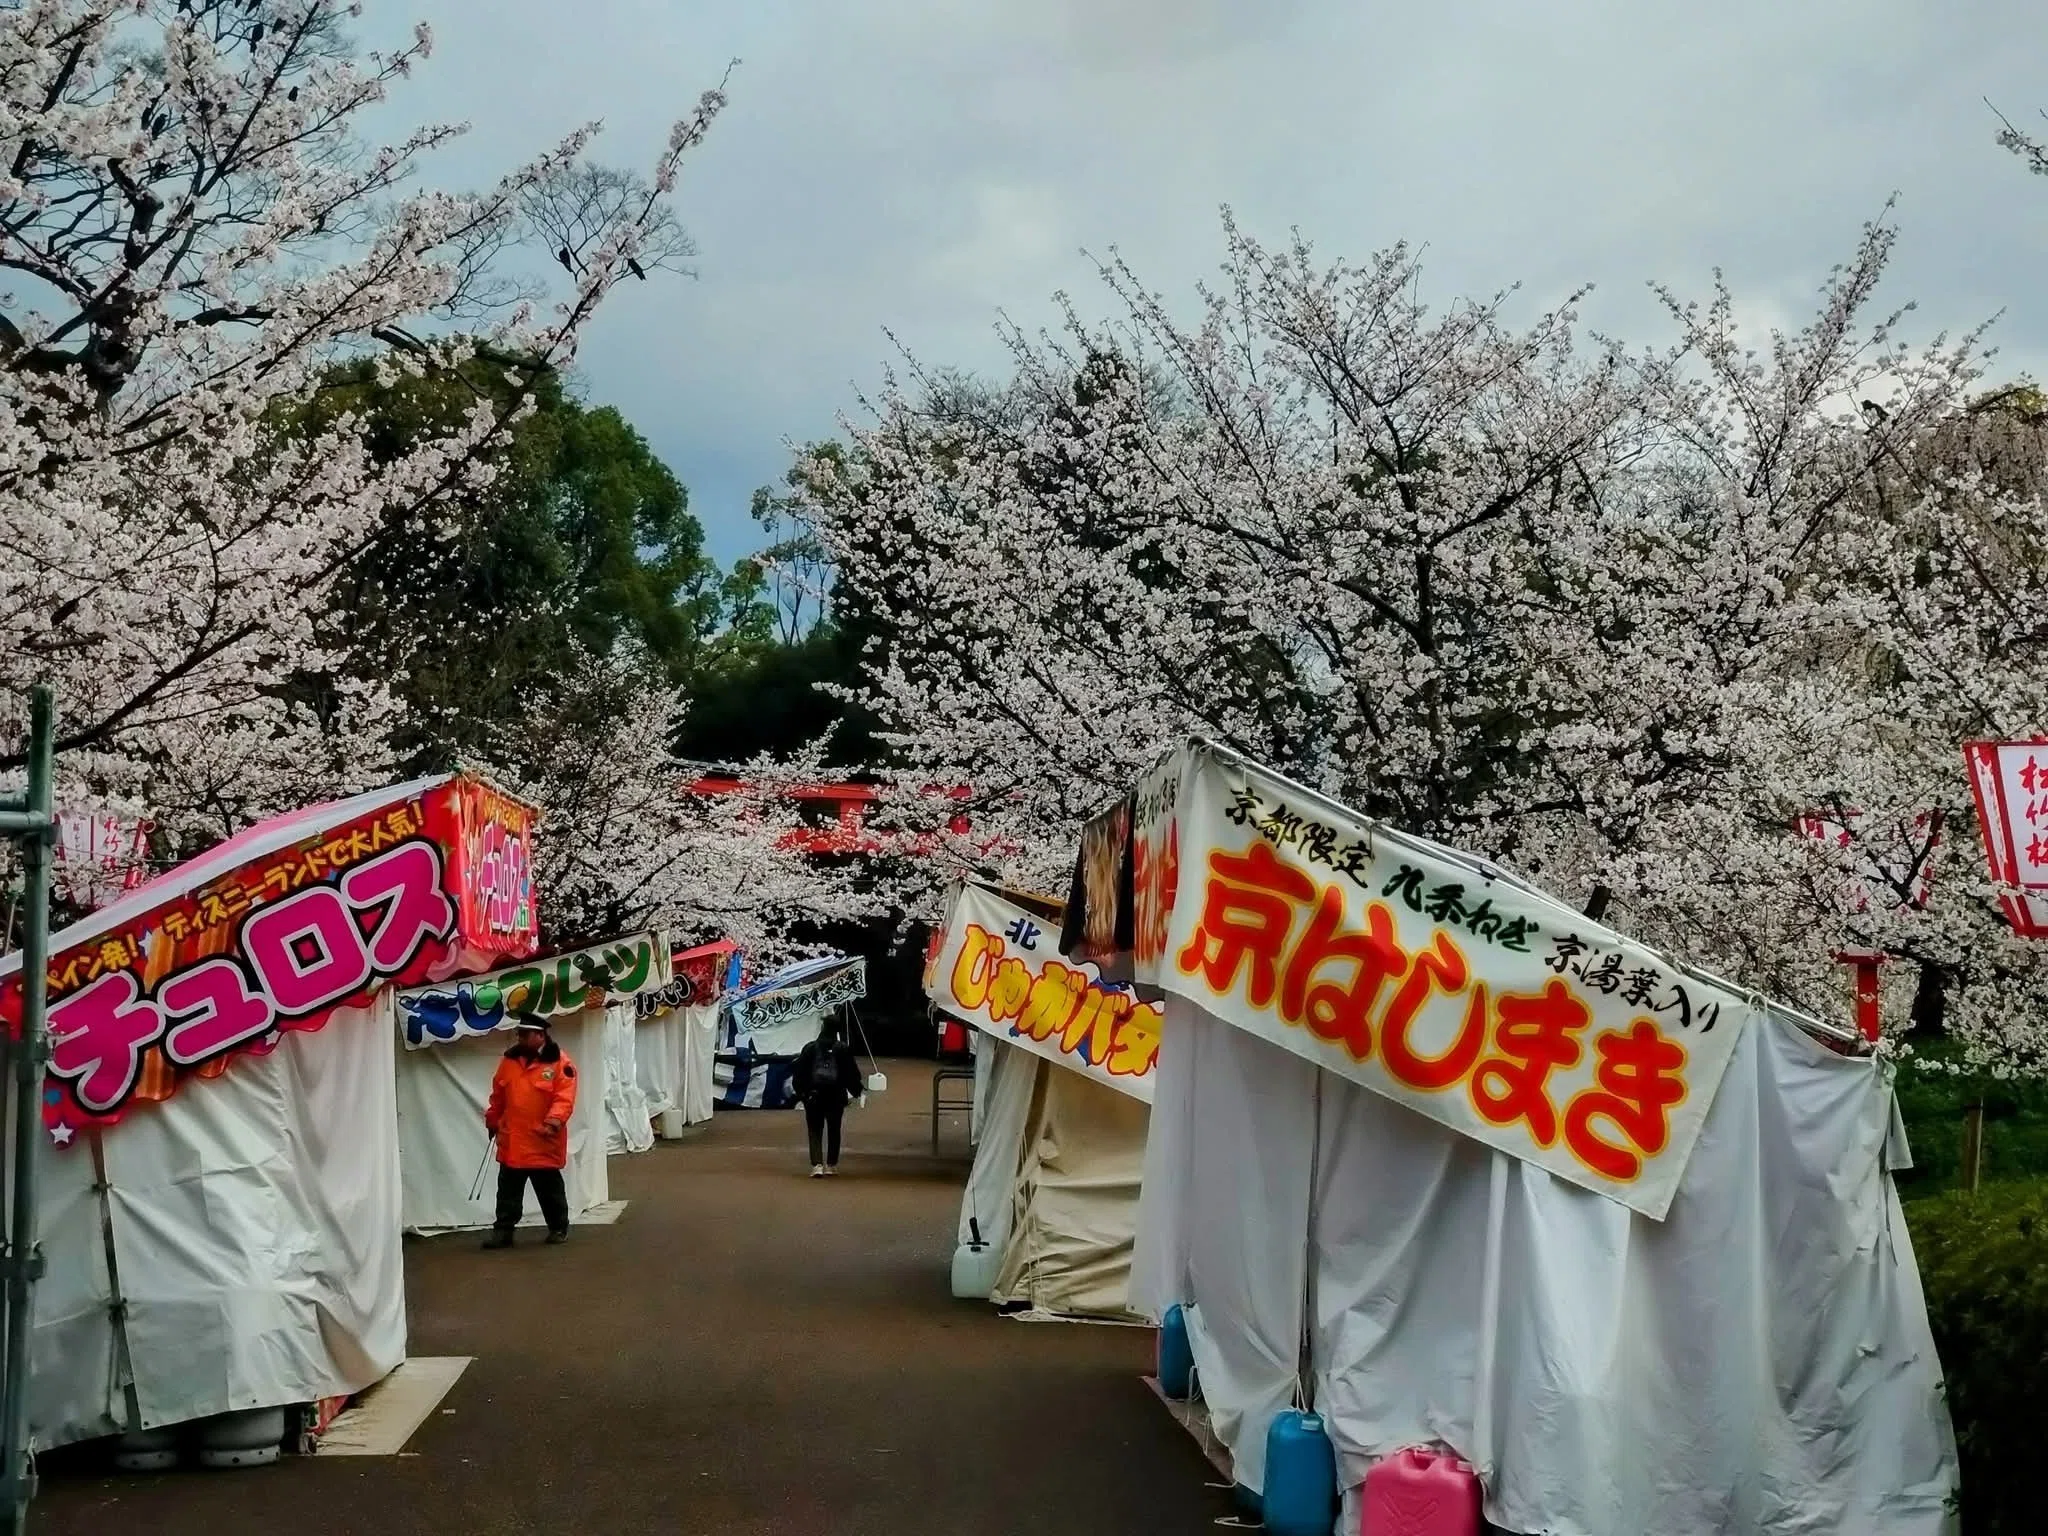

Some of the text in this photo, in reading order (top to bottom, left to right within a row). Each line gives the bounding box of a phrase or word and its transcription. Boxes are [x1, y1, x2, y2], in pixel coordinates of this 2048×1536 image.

[16, 933, 139, 992] ペイン発!
[163, 801, 425, 940] ディズニーランドで大人気!
[46, 841, 455, 1110] チュロス
[1004, 918, 1042, 950] 北
[1178, 842, 1689, 1184] 京はしまき
[1225, 787, 1375, 889] 京都限定
[1382, 864, 1539, 952] 九条ねぎ
[1545, 933, 1720, 1033] 京湯葉入り
